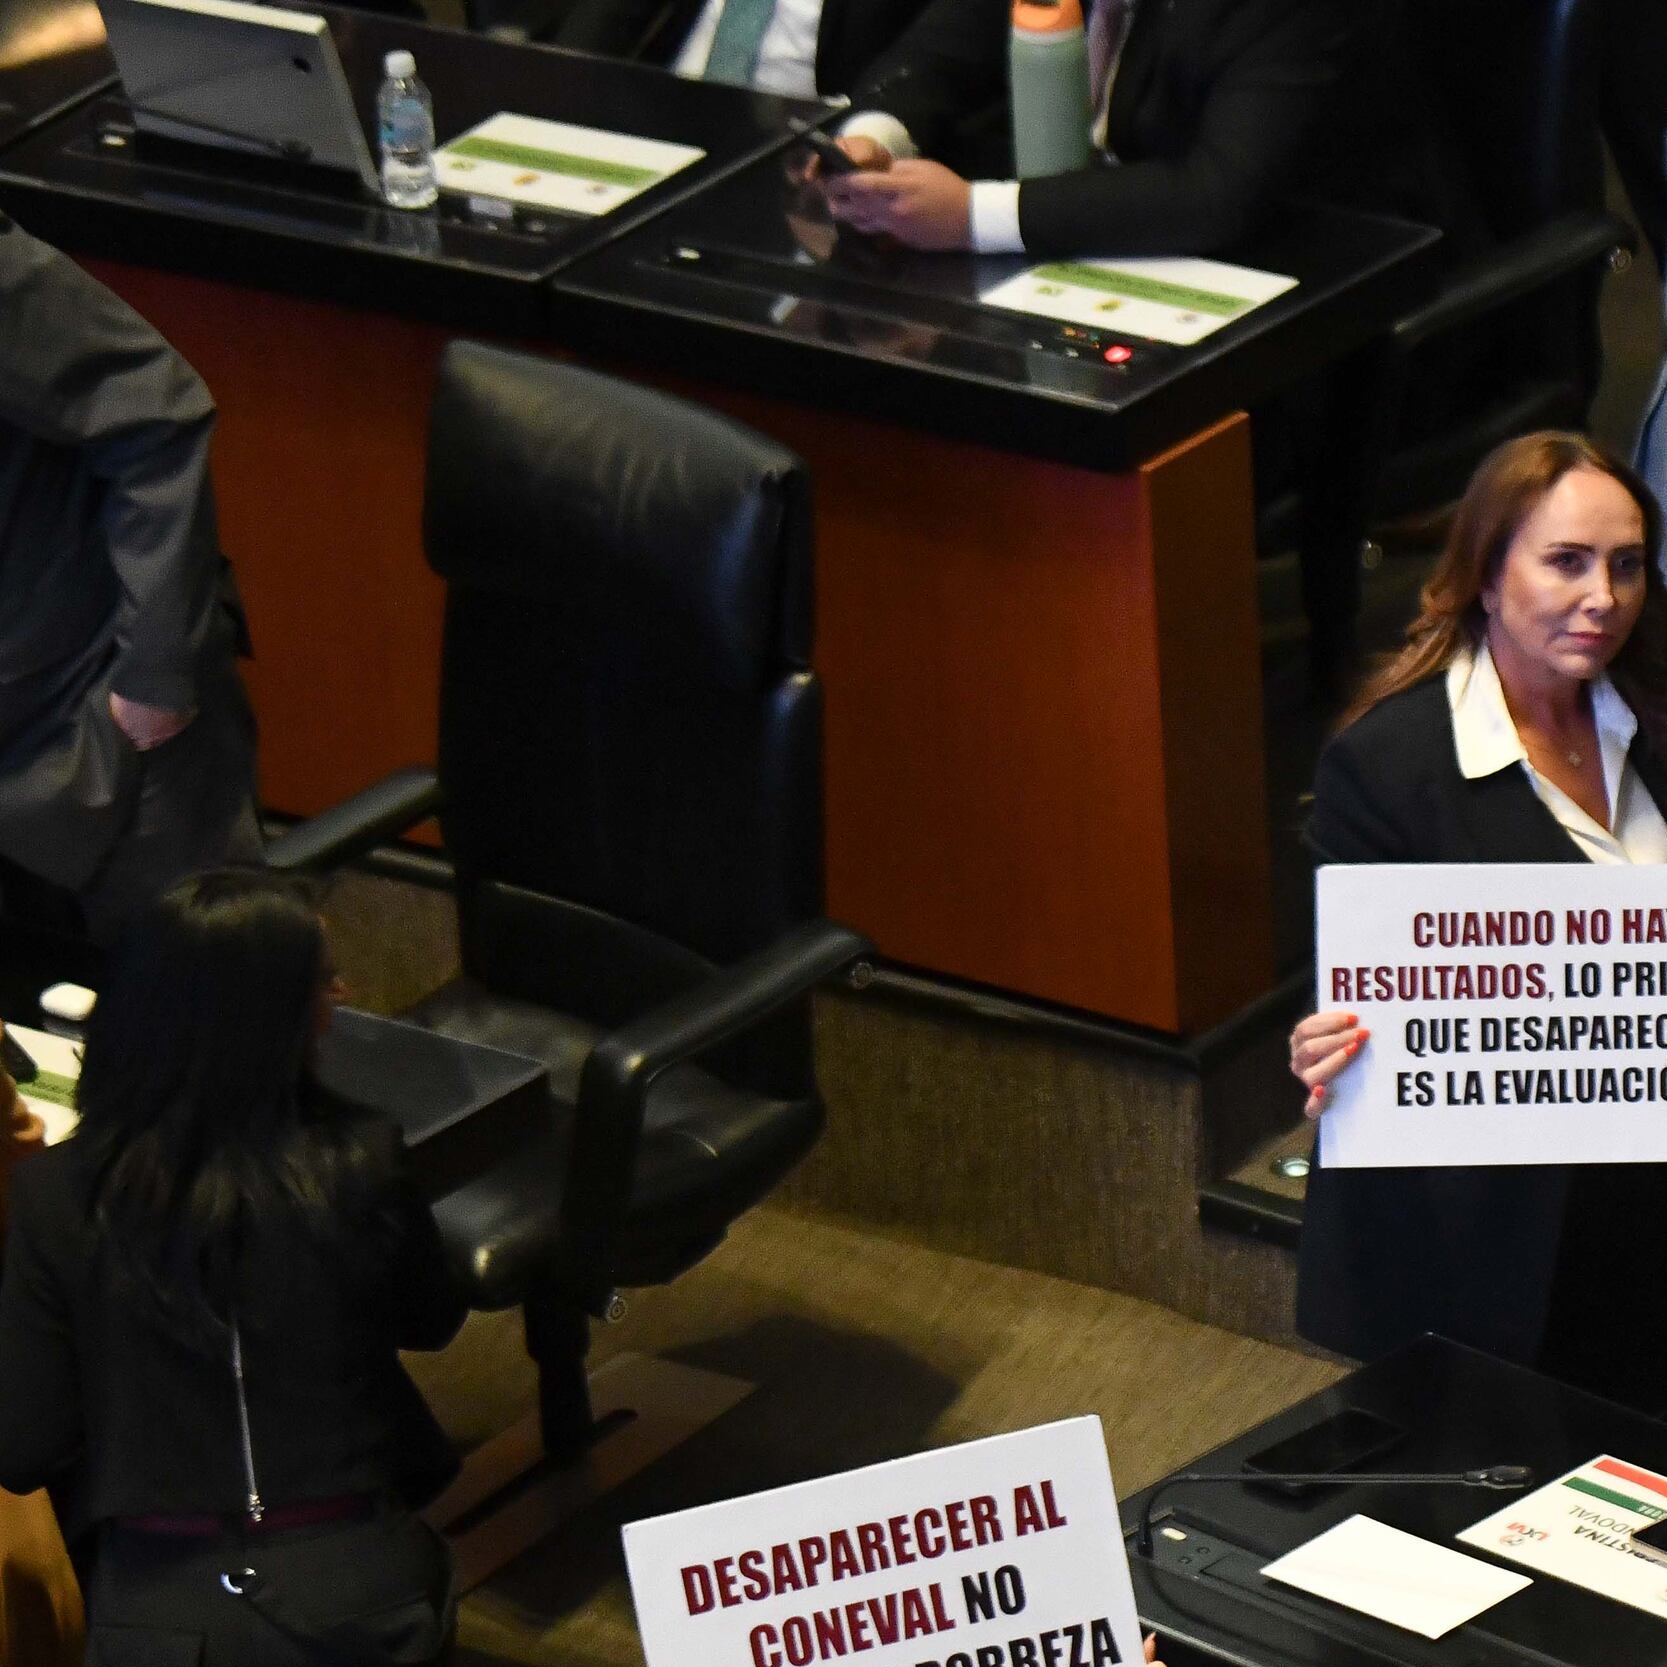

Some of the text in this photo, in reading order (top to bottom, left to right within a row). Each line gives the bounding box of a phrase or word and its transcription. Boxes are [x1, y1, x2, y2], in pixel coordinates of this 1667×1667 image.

[1414, 910, 1554, 947] CUANDO
[1567, 909, 1610, 945] NO
[1332, 964, 1553, 1002] RESULTADOS,
[1565, 962, 1601, 998] LO
[1406, 1018, 1469, 1057] QUE
[1397, 1071, 1435, 1106] ES
[1447, 1071, 1484, 1105] LA
[681, 1480, 1066, 1616] DESAPARECER AL
[961, 1565, 1025, 1624] NO
